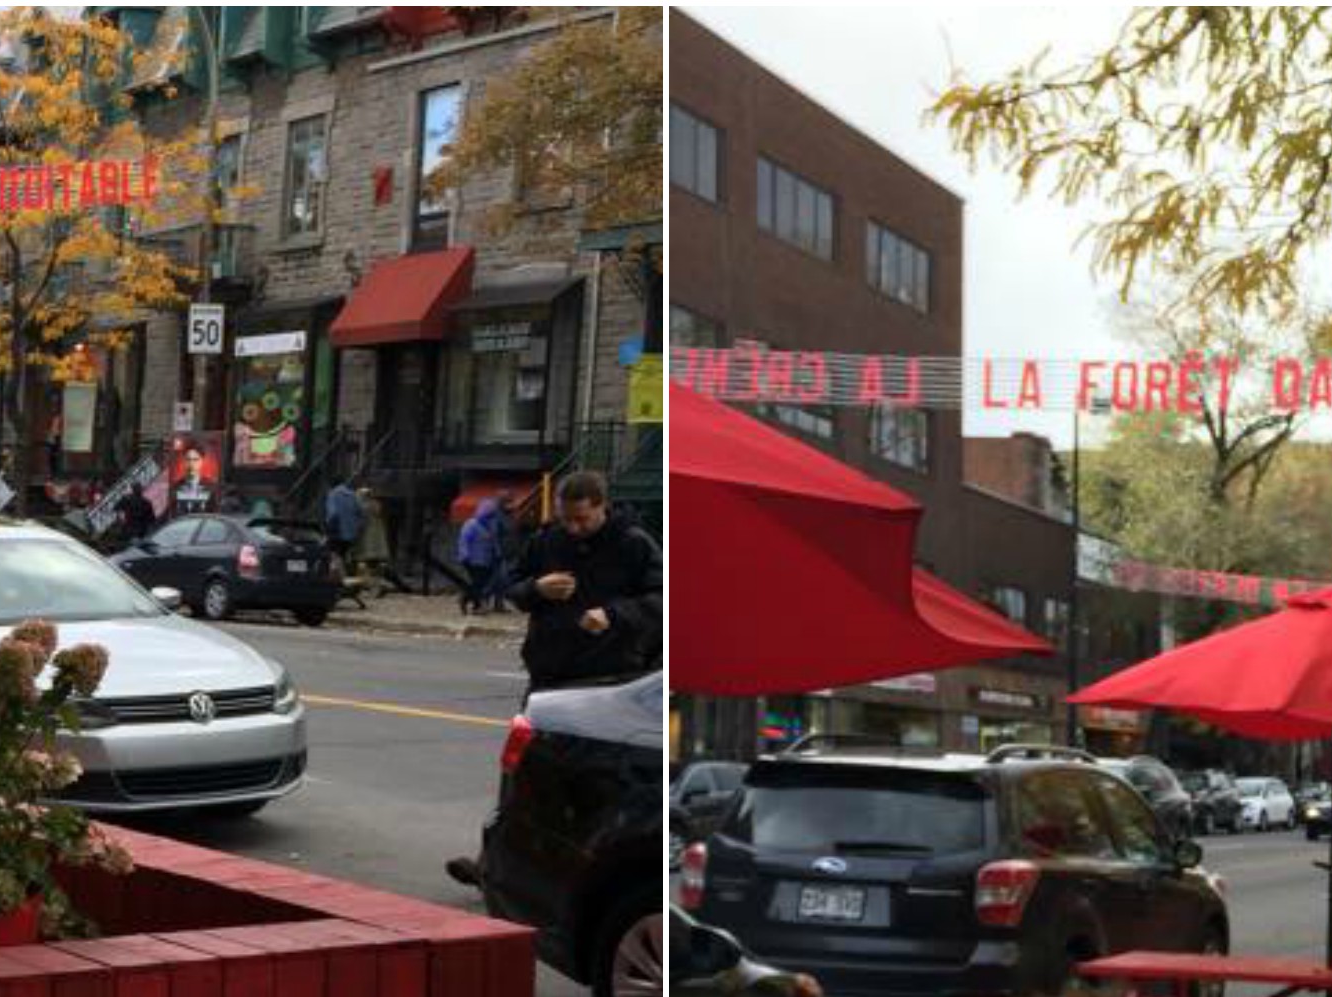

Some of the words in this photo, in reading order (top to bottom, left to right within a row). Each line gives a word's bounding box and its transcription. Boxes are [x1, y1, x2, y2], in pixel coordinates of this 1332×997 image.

[192, 319, 220, 346] 50
[982, 354, 1040, 408] LA
[1077, 349, 1240, 411] FORÊT
